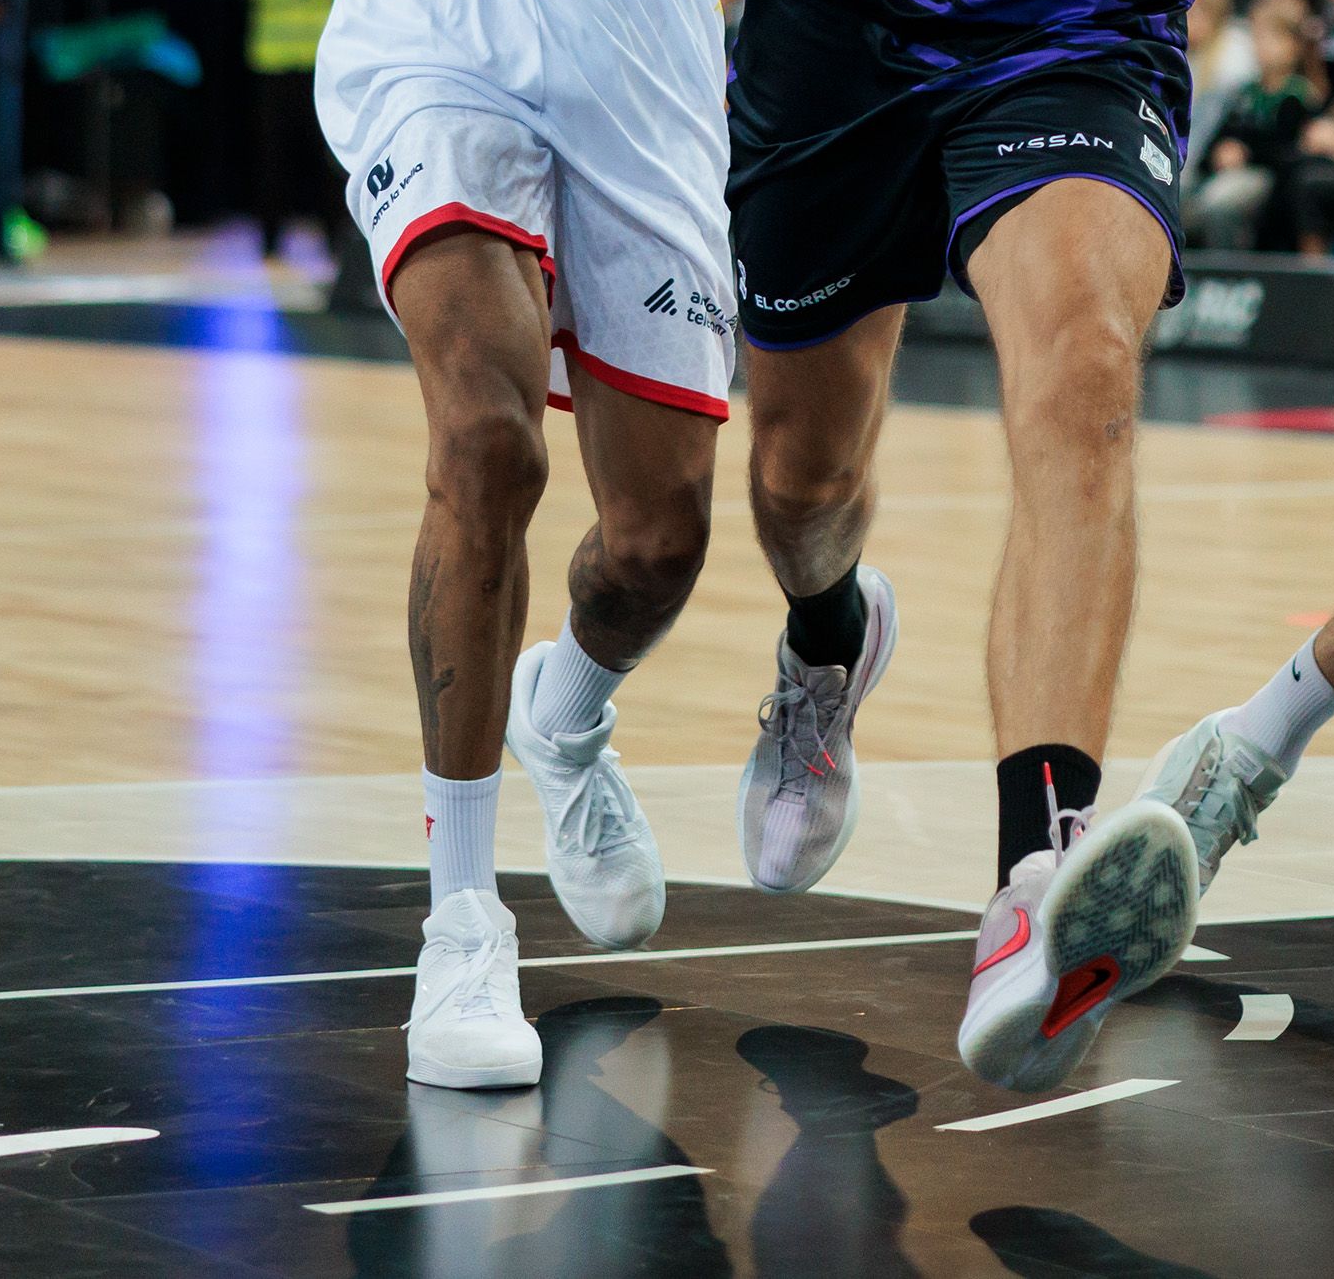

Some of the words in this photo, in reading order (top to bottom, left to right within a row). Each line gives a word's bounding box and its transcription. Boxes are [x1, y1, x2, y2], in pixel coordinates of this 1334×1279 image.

[997, 132, 1113, 156] NISSAN
[755, 293, 773, 310] EL
[774, 277, 852, 312] CORREO
